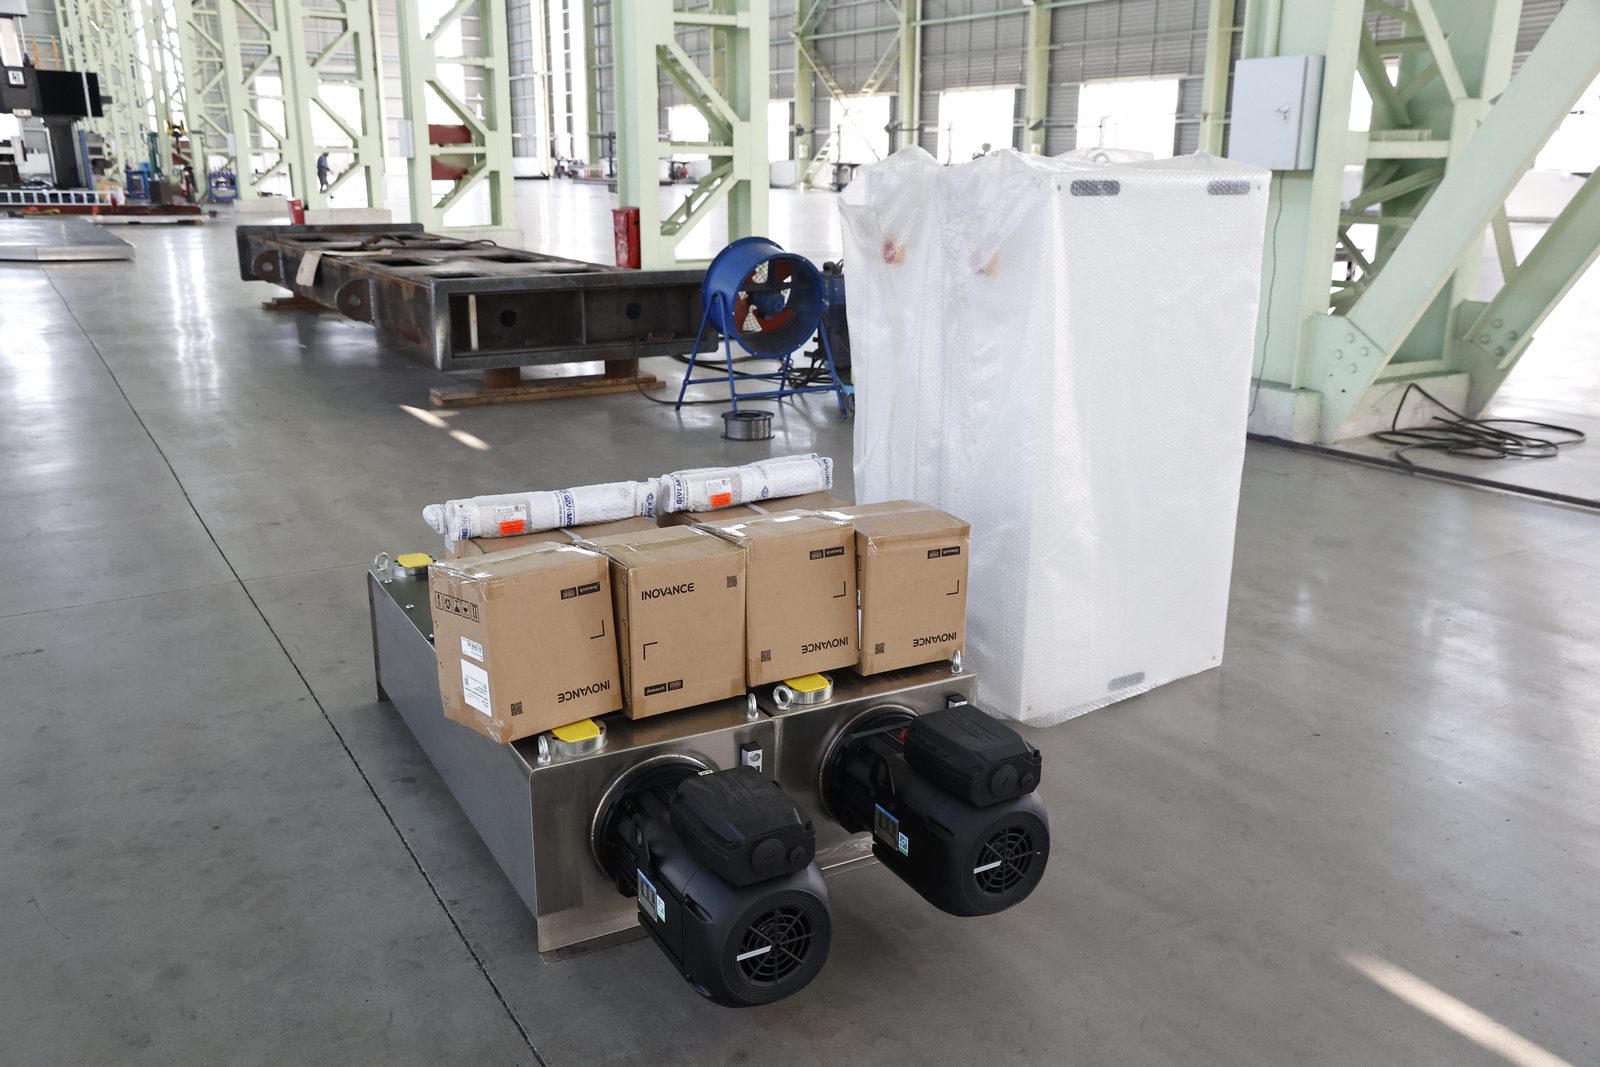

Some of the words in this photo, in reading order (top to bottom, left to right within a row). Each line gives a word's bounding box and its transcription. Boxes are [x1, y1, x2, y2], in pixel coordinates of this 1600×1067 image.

[641, 582, 695, 600] INOVANCE
[801, 636, 849, 655] INOVANCE
[913, 631, 957, 648] INOVANCE
[557, 680, 610, 703] INOVANCE
